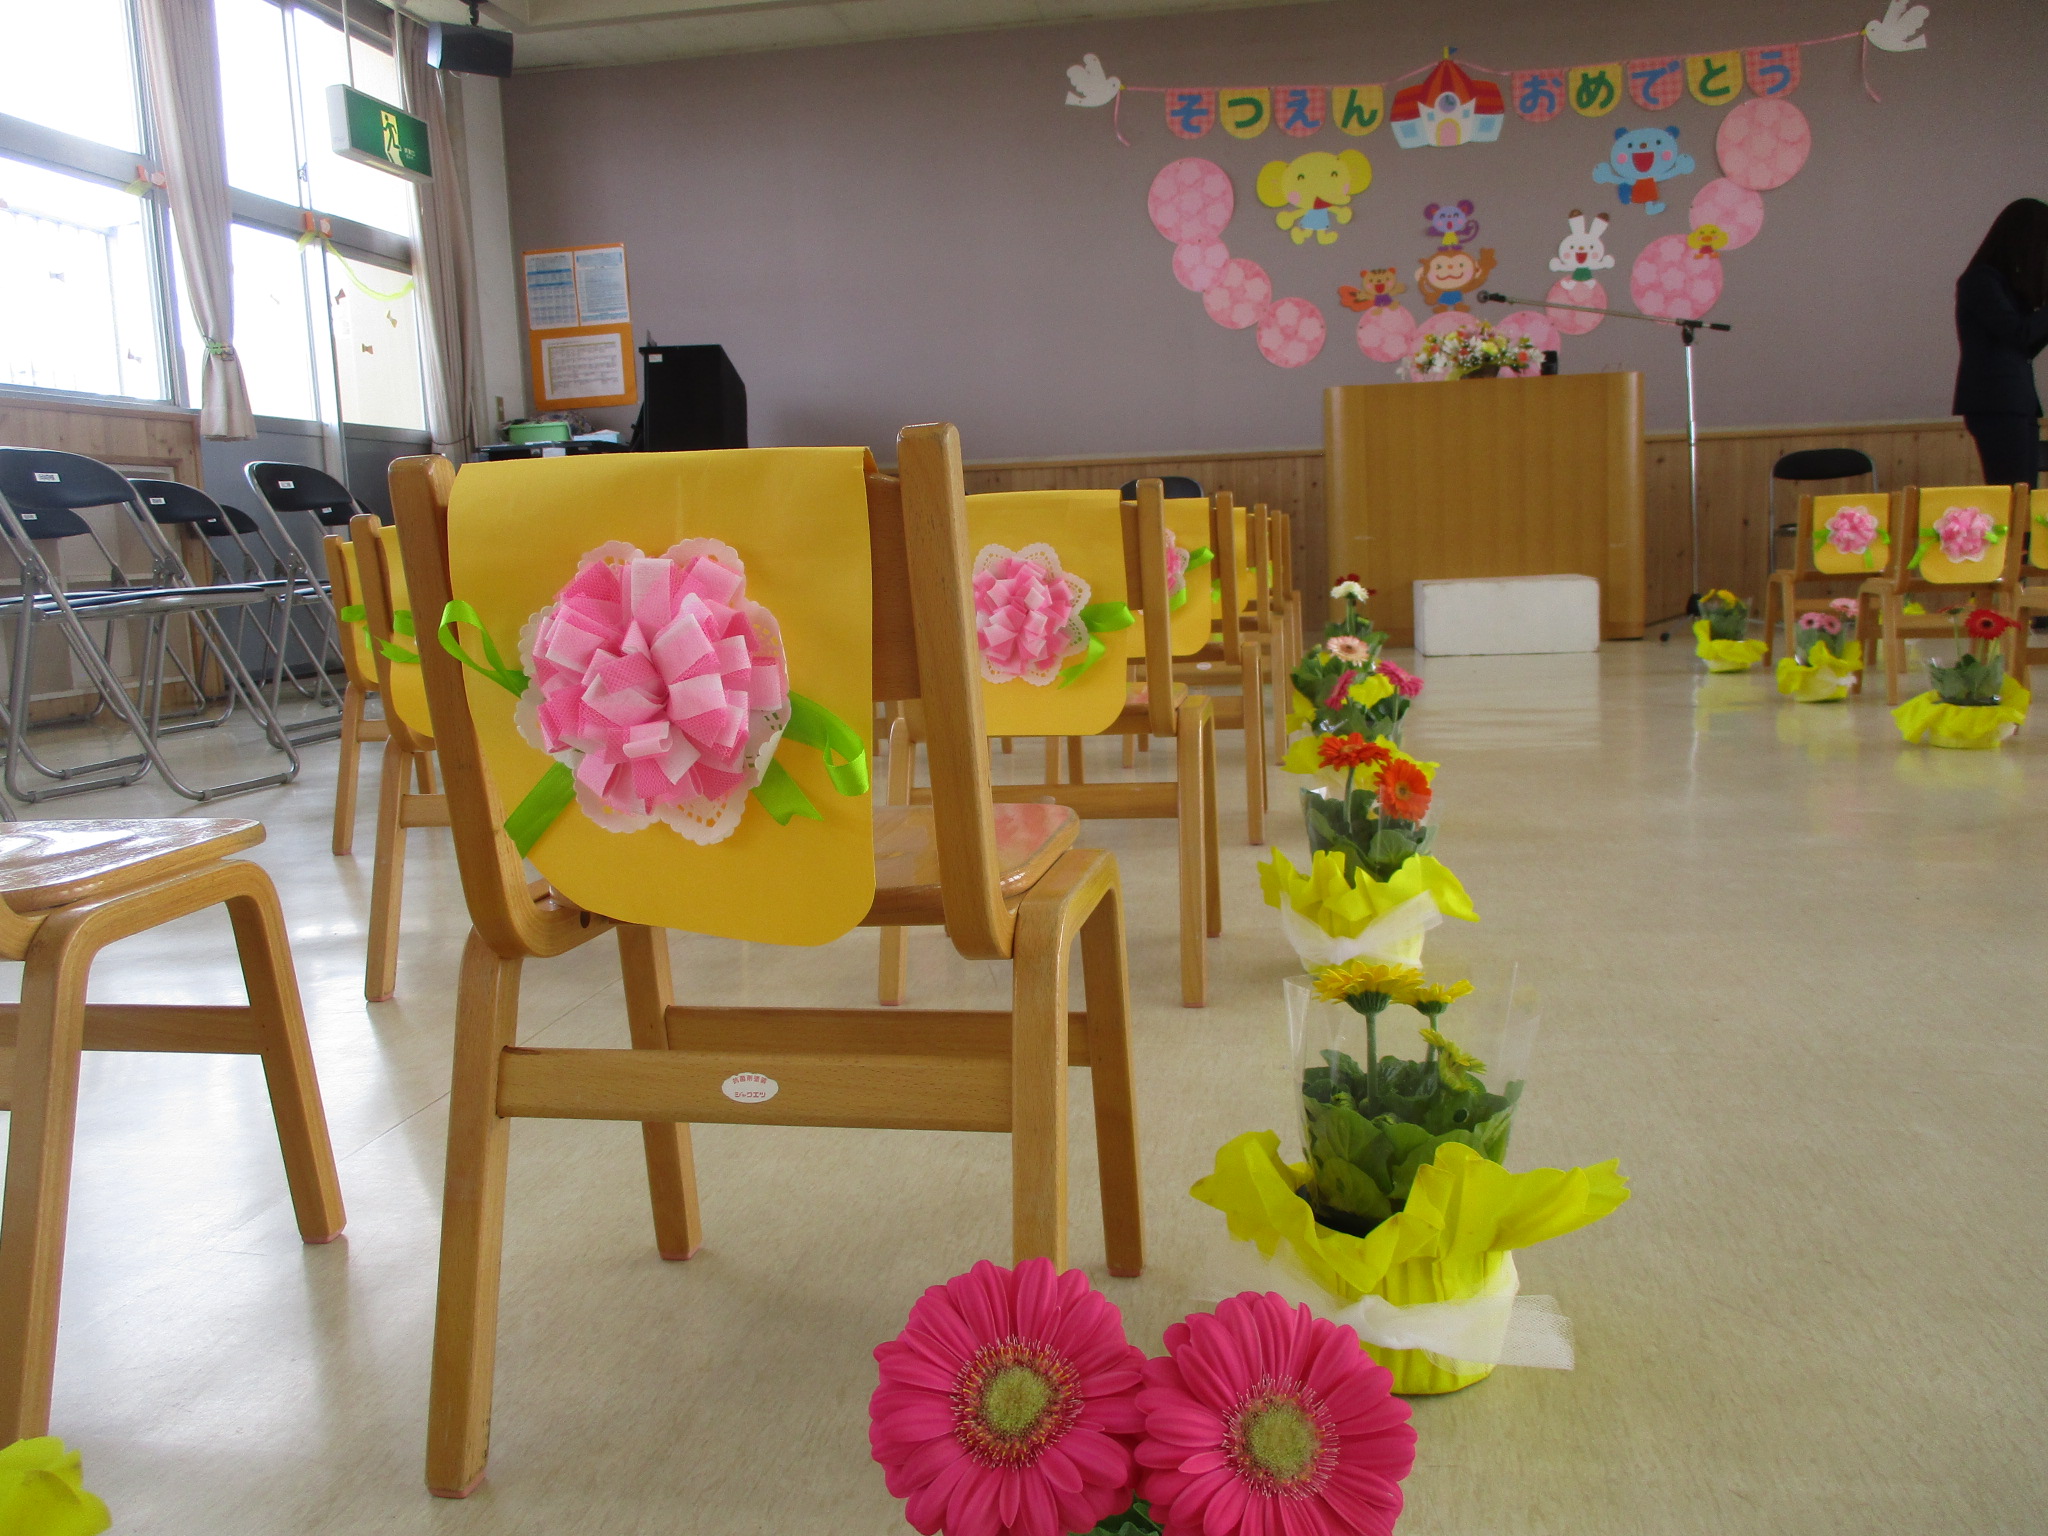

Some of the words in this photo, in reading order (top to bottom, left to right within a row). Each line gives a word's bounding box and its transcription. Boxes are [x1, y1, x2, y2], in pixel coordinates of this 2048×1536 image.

[1170, 88, 1378, 133] そつえん
[1519, 51, 1792, 115] おめでとう
